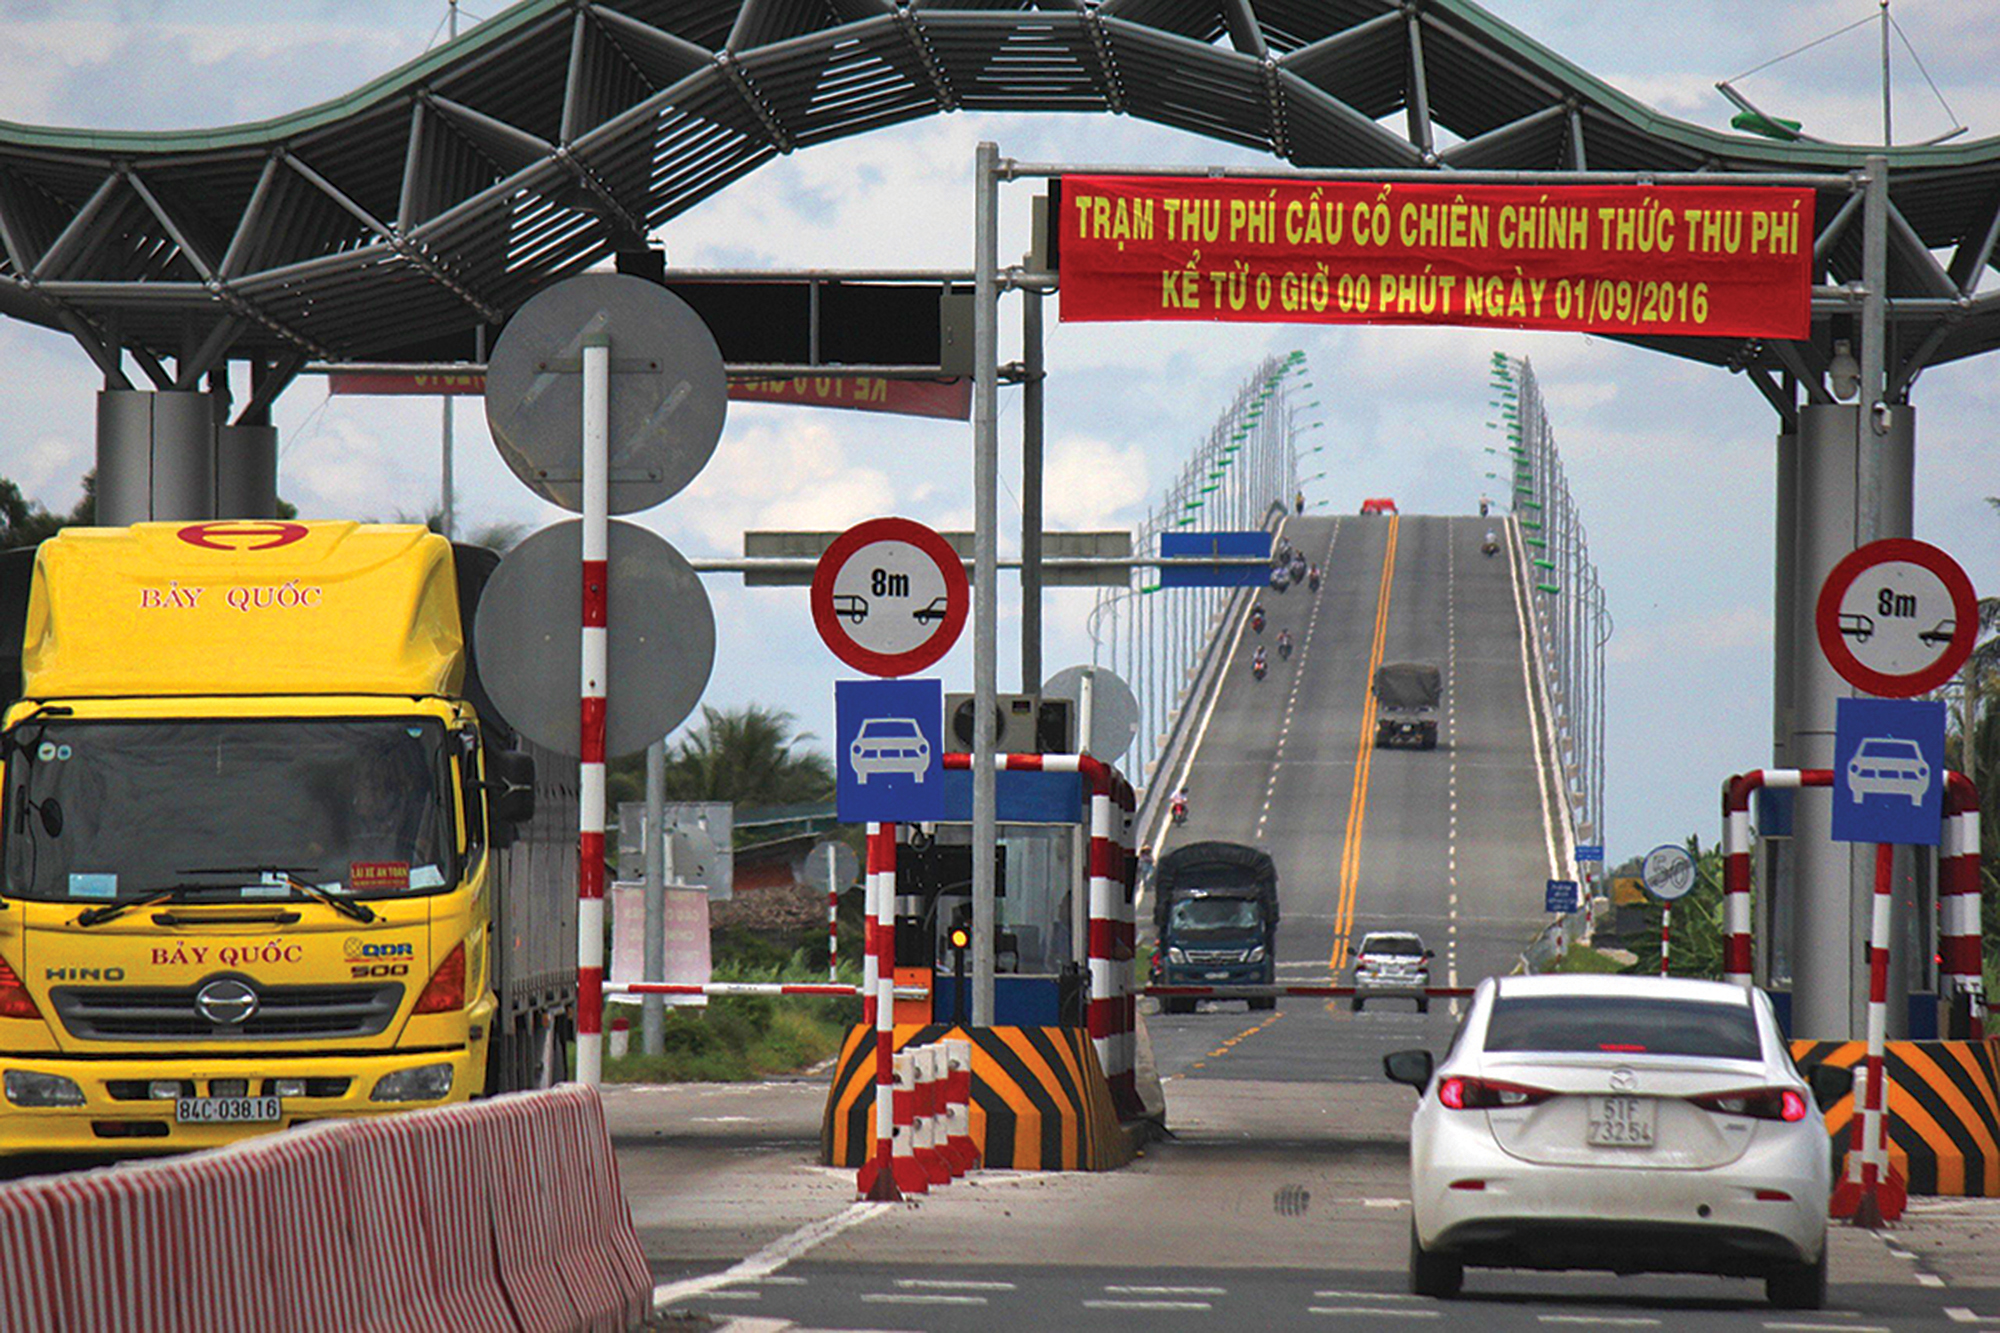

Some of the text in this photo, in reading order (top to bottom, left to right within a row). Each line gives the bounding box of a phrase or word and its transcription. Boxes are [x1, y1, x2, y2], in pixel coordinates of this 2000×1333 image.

[1075, 183, 1801, 256] TRẠM THU PHÍ CẦU CỔ CHIÊN CHÍNH THỨC THU PHÍ
[1161, 248, 1709, 326] KỂ TỪ 0 GIỜ 00 PHÚT NGÀY 01/09/2016
[140, 578, 322, 612] BẢY QUỐC
[871, 567, 909, 598] 8m
[1878, 587, 1917, 618] 8m
[151, 938, 303, 967] BẢY QUỐC
[362, 943, 413, 957] QDR
[45, 967, 126, 982] HINO
[351, 964, 409, 978] 500
[1603, 1099, 1640, 1120] 51F
